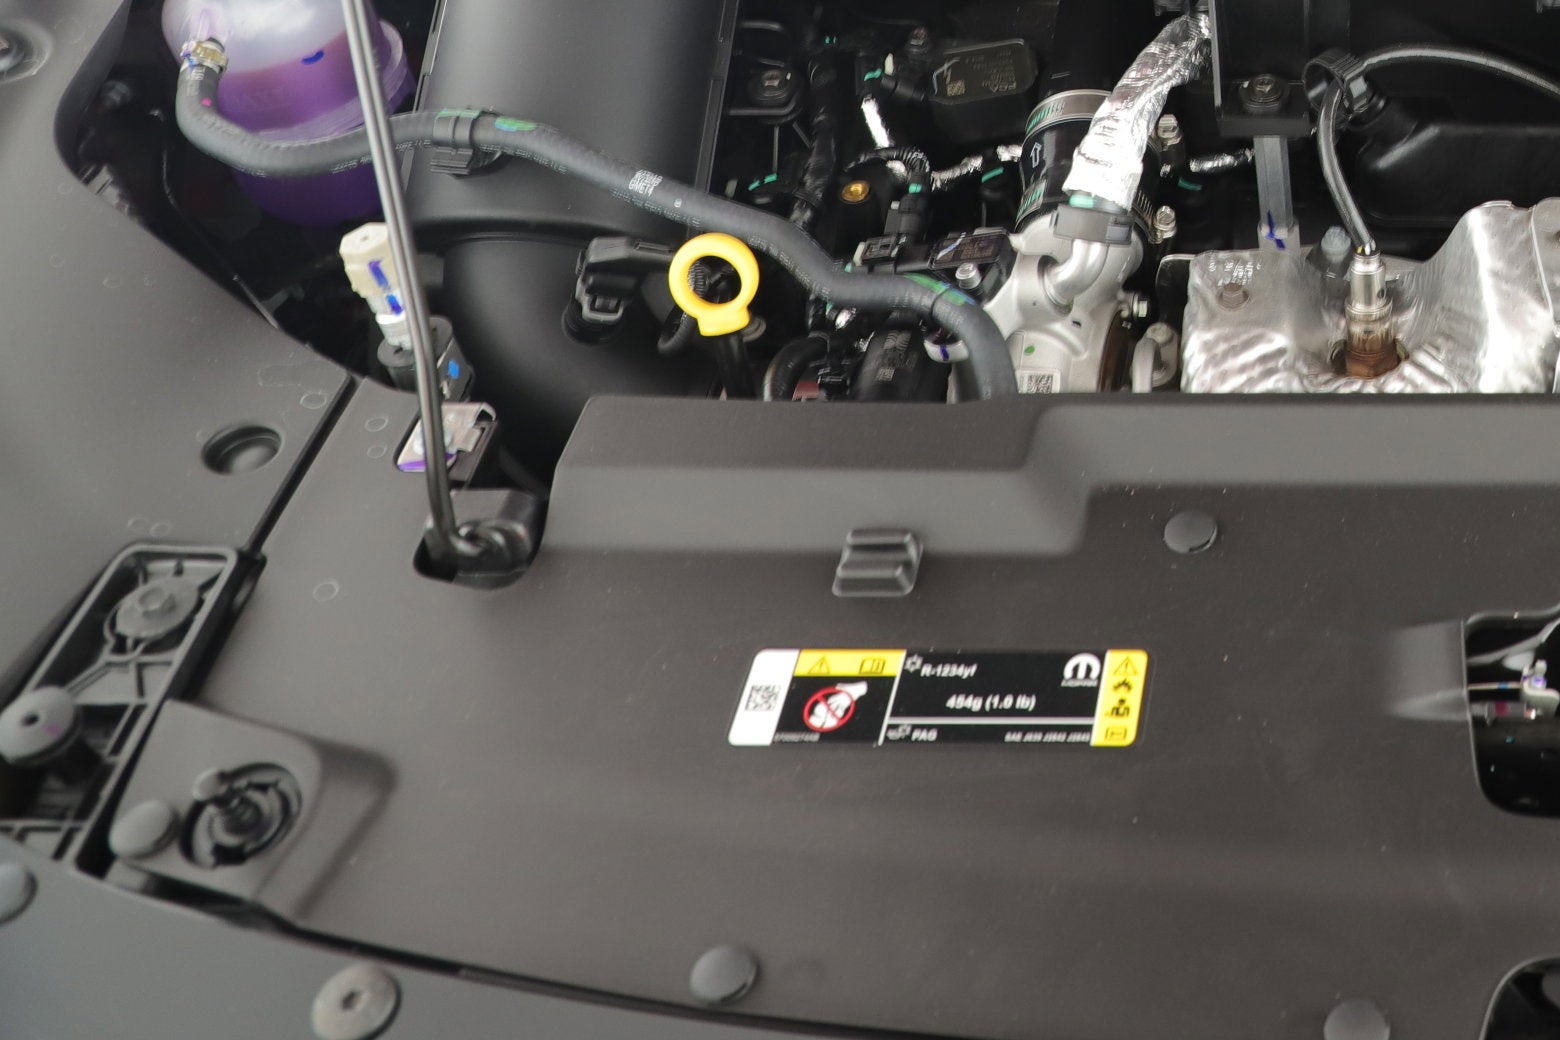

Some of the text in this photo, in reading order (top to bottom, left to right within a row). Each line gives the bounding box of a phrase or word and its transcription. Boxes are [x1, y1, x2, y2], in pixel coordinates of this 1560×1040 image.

[921, 663, 978, 678] R-1234yf
[945, 694, 1037, 711] 454g (1.0 lb)
[911, 729, 937, 741] PAG
